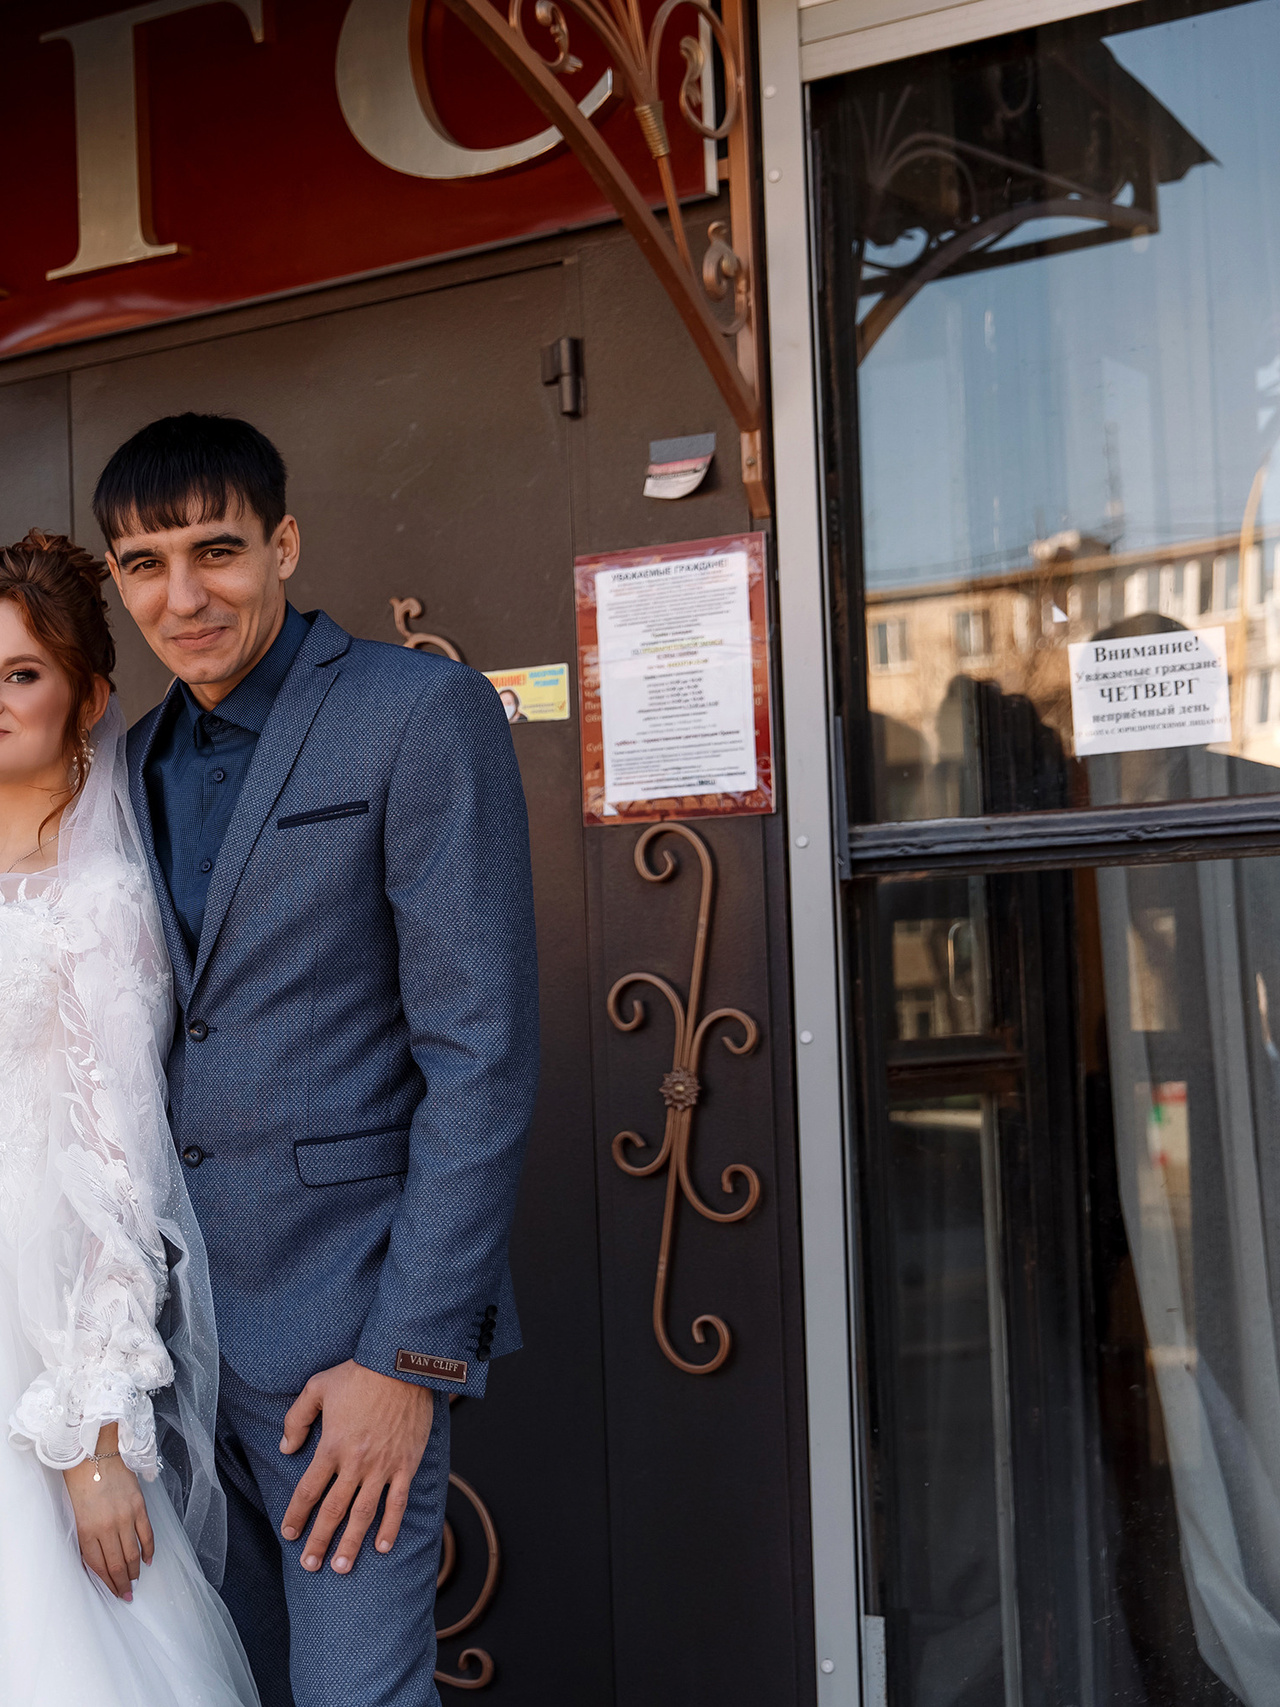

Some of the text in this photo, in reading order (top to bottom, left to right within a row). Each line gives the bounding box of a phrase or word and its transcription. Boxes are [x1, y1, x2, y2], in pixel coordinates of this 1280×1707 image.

[1094, 636, 1199, 663] Внимание!
[1075, 657, 1222, 683] Уважаемые граждане!
[1099, 678, 1200, 703] ЧЕТВЕРГ
[1092, 702, 1210, 724] неприёмный день
[410, 1355, 459, 1373] VAN CLIFF
